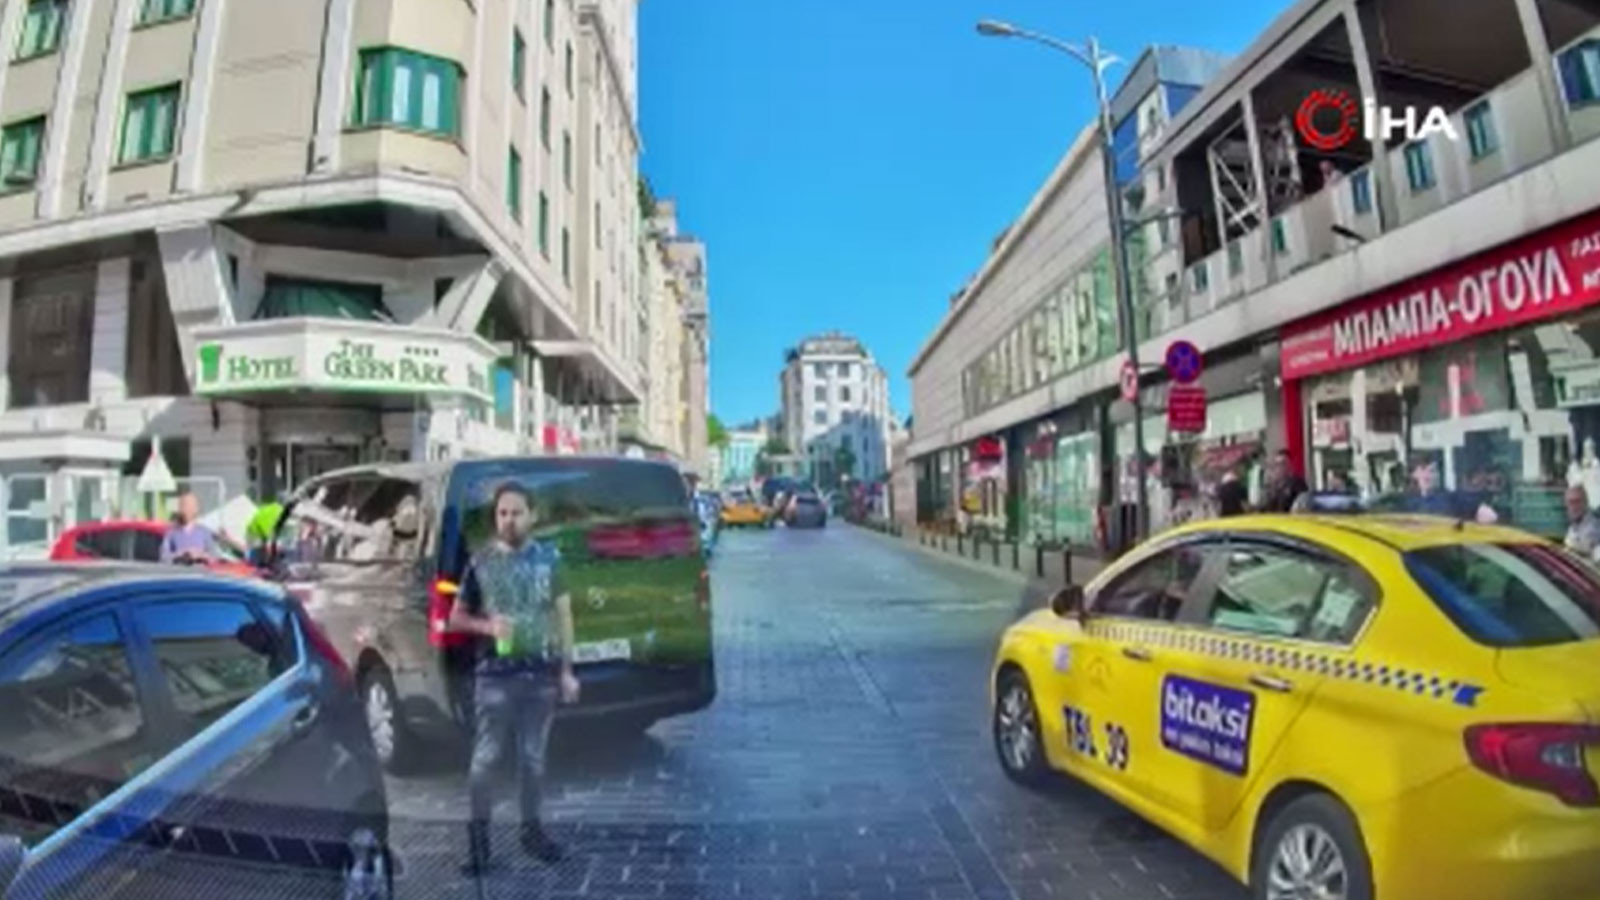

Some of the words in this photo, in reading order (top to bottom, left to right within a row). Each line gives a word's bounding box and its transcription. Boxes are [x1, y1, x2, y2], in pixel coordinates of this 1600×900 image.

[227, 354, 298, 381] HOTEL
[324, 352, 394, 380] GREEN
[400, 357, 448, 386] PARK
[1165, 681, 1251, 741] bitaksi
